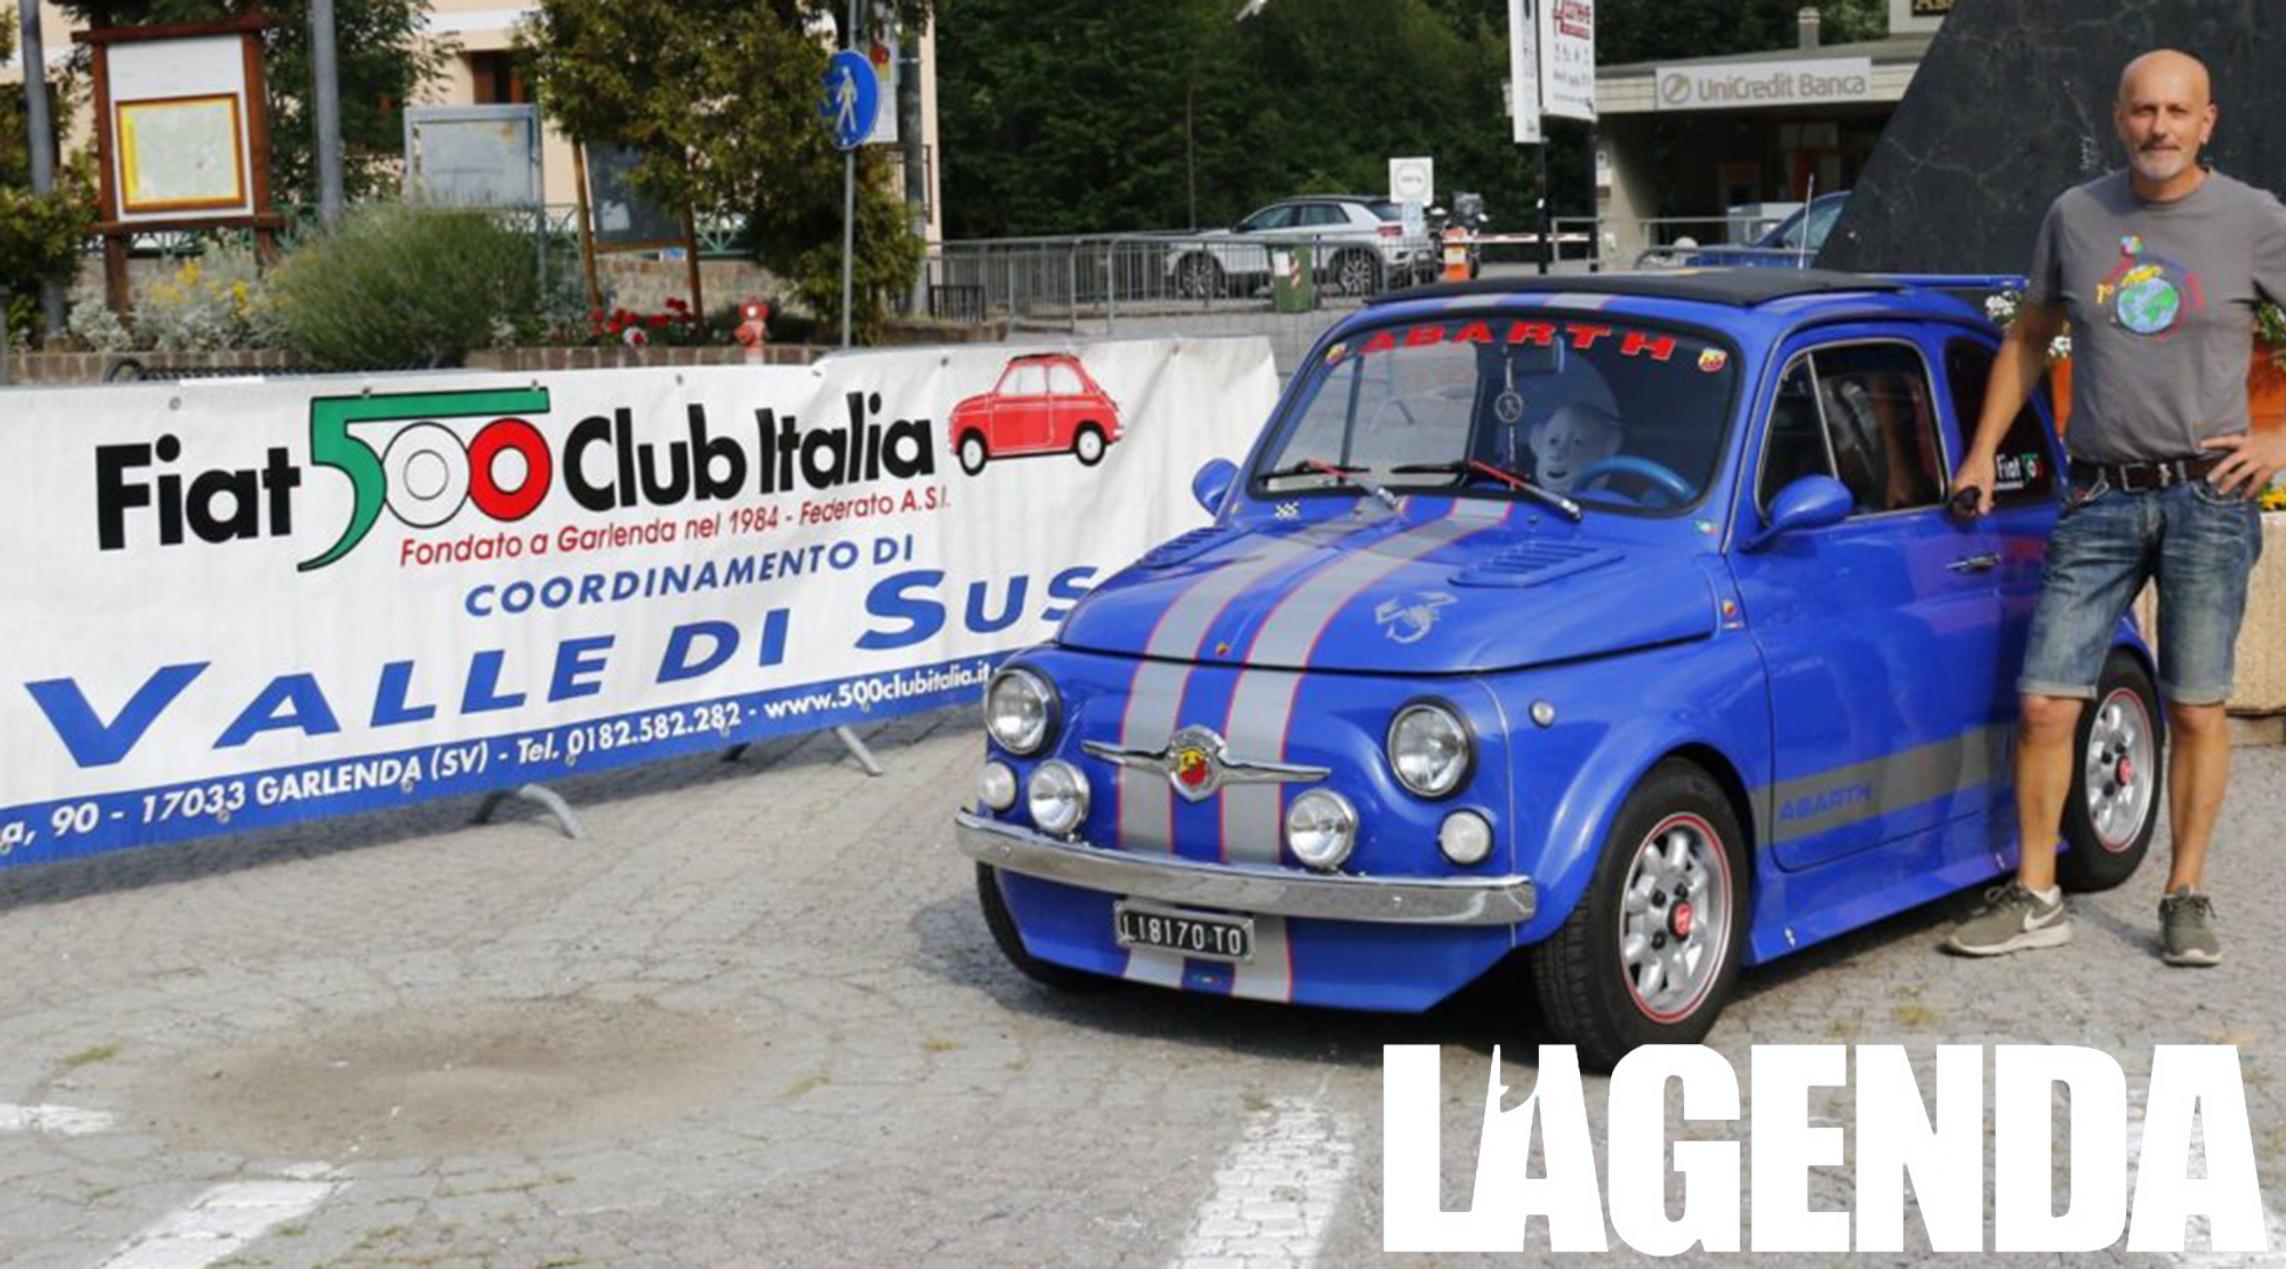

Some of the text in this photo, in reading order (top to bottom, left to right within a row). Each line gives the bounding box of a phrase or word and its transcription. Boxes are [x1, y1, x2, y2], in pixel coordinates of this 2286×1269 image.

[1699, 72, 1865, 101] UniCredit Banca
[1359, 320, 1676, 361] ABARTH
[95, 386, 935, 572] Fiat 500 Club Italia
[400, 533, 523, 567] Fondato
[530, 534, 549, 555] a
[556, 518, 677, 552] Garlenda
[684, 512, 721, 540] nel
[729, 505, 779, 534] 1984
[799, 494, 894, 526] Federato
[901, 485, 951, 513] A.S.I.
[465, 534, 914, 618] COORDINAMENTO DI
[23, 566, 1099, 769] VALLE DI SUS
[0, 821, 37, 846] a,
[51, 802, 99, 837] 90
[142, 781, 246, 823] 17033
[256, 757, 422, 806] GARLENDA
[431, 740, 489, 779] (SV)
[517, 732, 559, 764] Tel.
[566, 701, 742, 757] 0182.582.282
[763, 660, 990, 720] www.500clubitalia.it
[1213, 925, 1243, 956] TO
